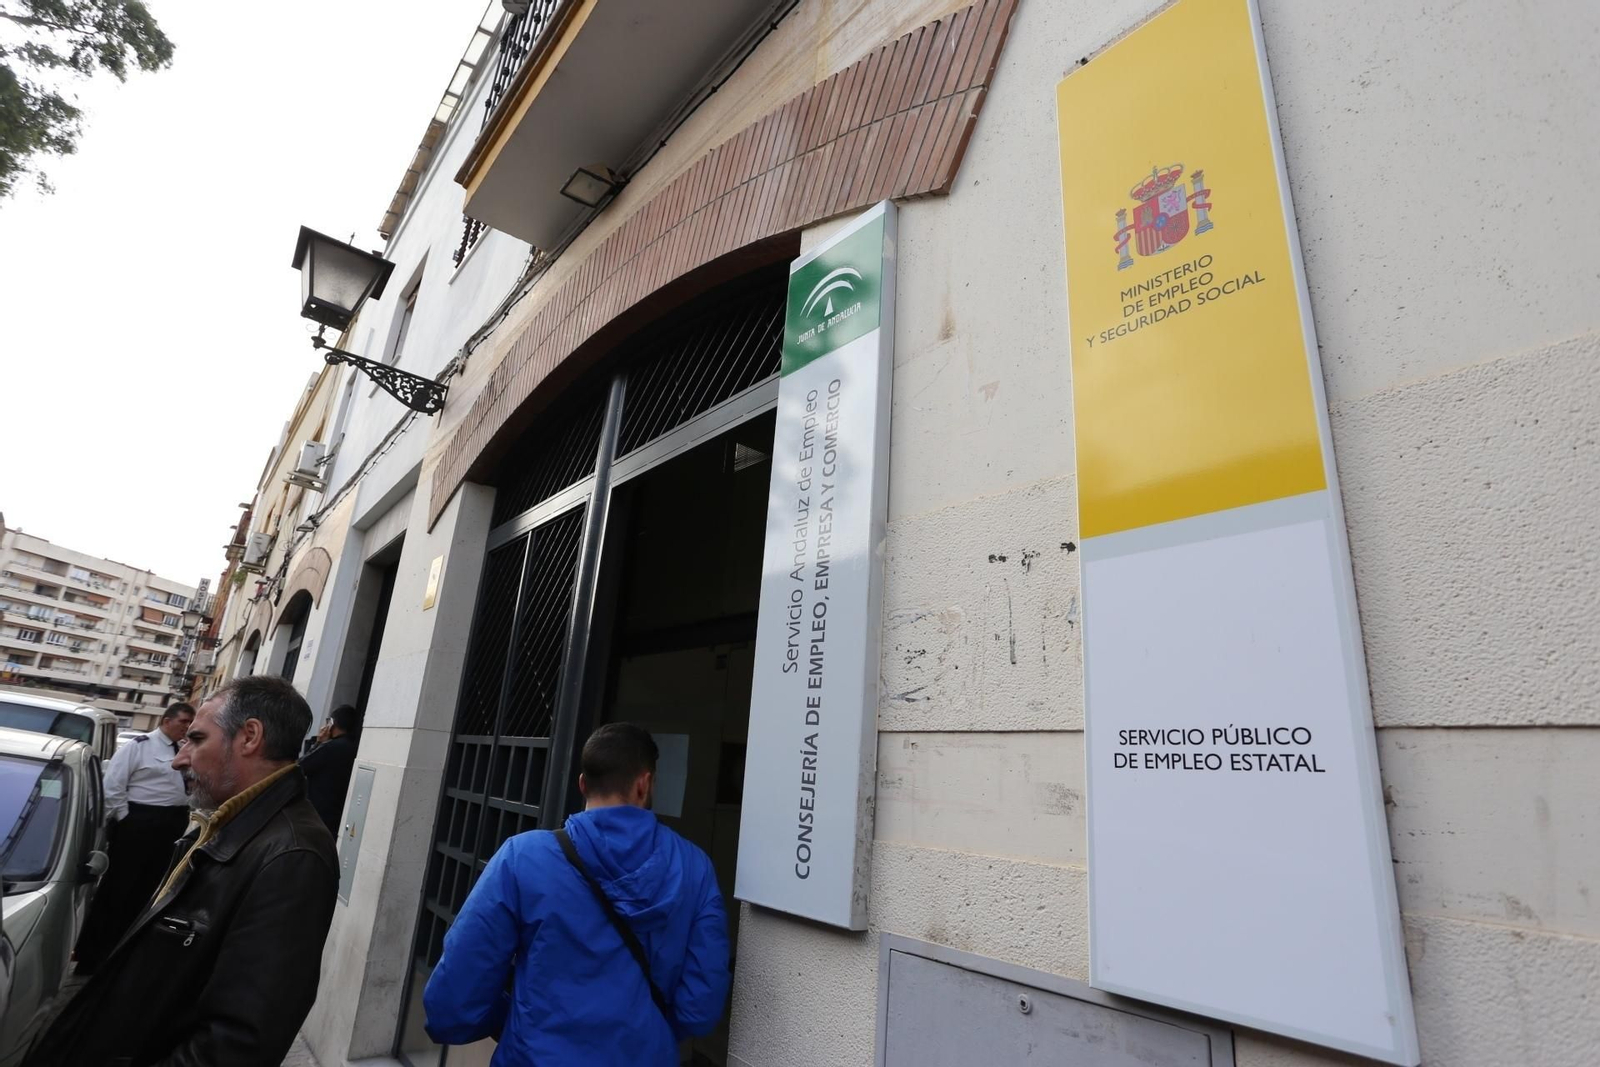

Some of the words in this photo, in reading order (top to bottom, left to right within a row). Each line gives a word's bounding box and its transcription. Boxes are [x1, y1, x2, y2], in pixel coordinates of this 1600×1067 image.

[1120, 254, 1213, 302] MINISTERIO
[1123, 300, 1144, 318] DE
[1149, 272, 1213, 307] EMPLEO
[1086, 336, 1095, 348] Y
[1099, 299, 1192, 344] SEGURIDAD
[1196, 270, 1266, 306] SOCIAL
[796, 328, 816, 345] JUNTA
[817, 322, 826, 334] DE
[800, 389, 819, 463] Empleo
[822, 378, 842, 478] COMERCIO
[799, 466, 813, 492] de
[821, 482, 835, 495] Y
[789, 496, 811, 582] Andaluz
[814, 496, 834, 591] EMPRESA
[194, 580, 209, 610] HOSTA
[782, 589, 804, 674] Servicio
[807, 595, 830, 689] EMPLEO,
[805, 696, 822, 726] DE
[1118, 728, 1205, 746] SERVICIO
[1211, 724, 1312, 746] PÚBLICO
[1113, 752, 1139, 769] DE
[1144, 753, 1223, 771] EMPLEO
[1230, 753, 1326, 773] ESTATAL
[795, 732, 819, 880] CONSEJERÍA
